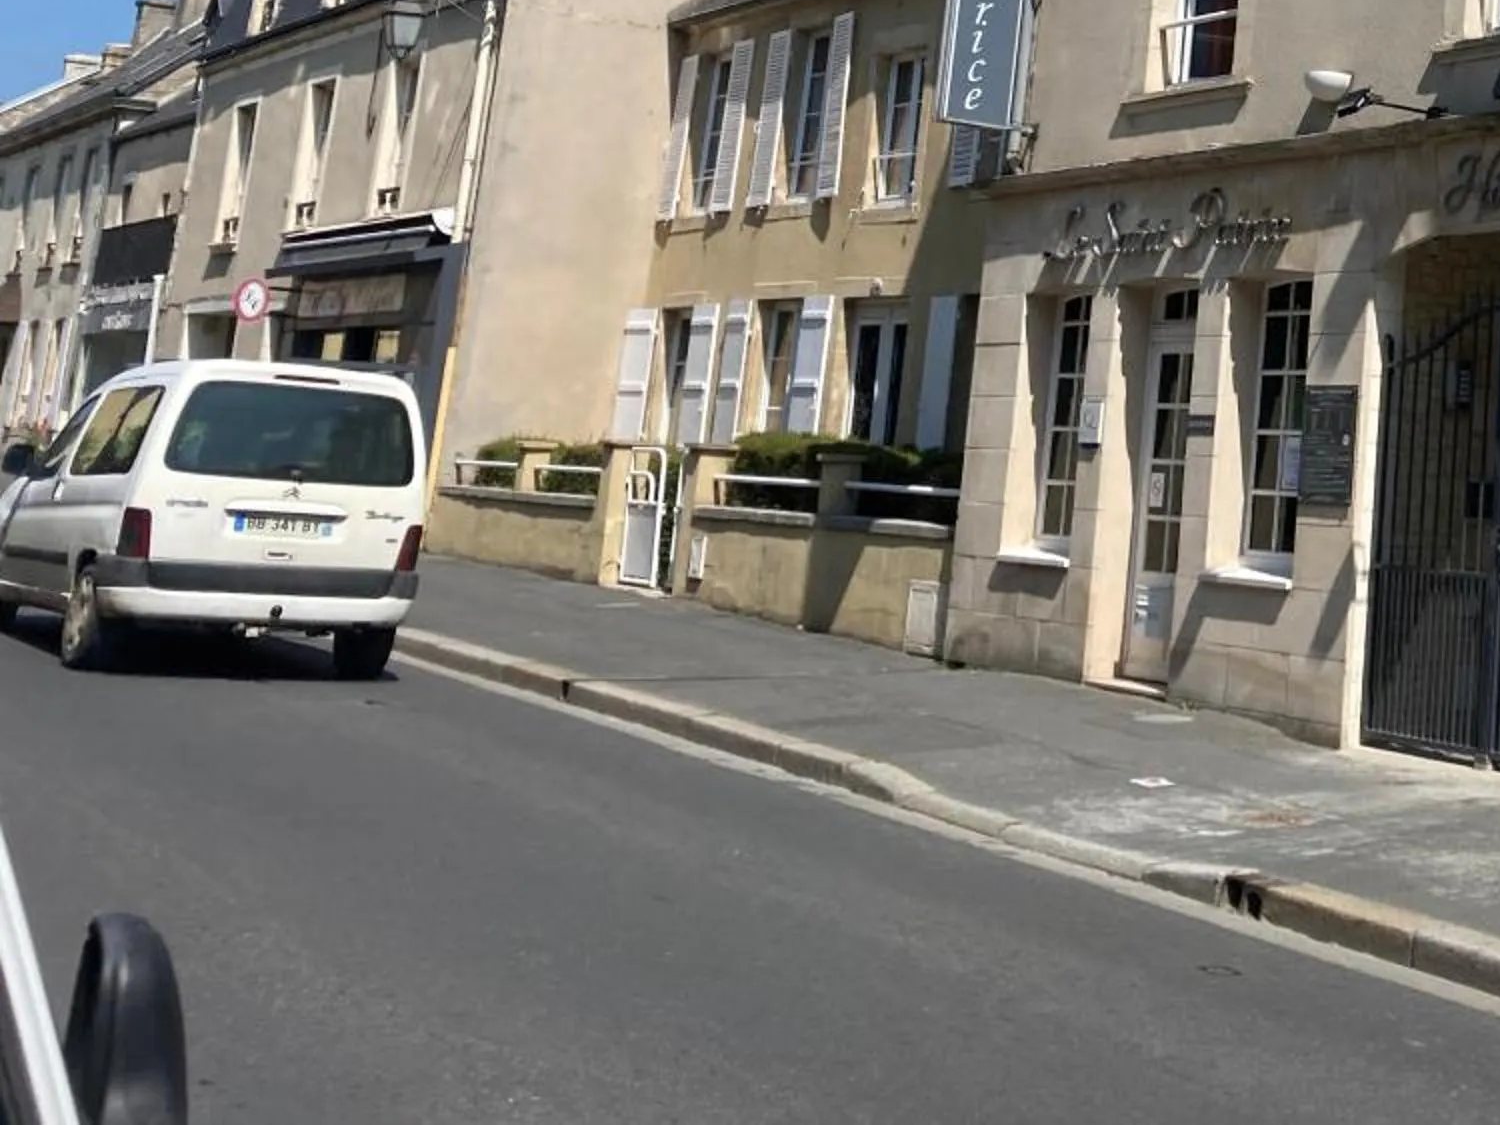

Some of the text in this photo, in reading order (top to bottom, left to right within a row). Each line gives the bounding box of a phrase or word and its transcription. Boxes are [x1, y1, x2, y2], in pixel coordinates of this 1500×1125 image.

[1042, 186, 1293, 261] Le Saint Patrice
